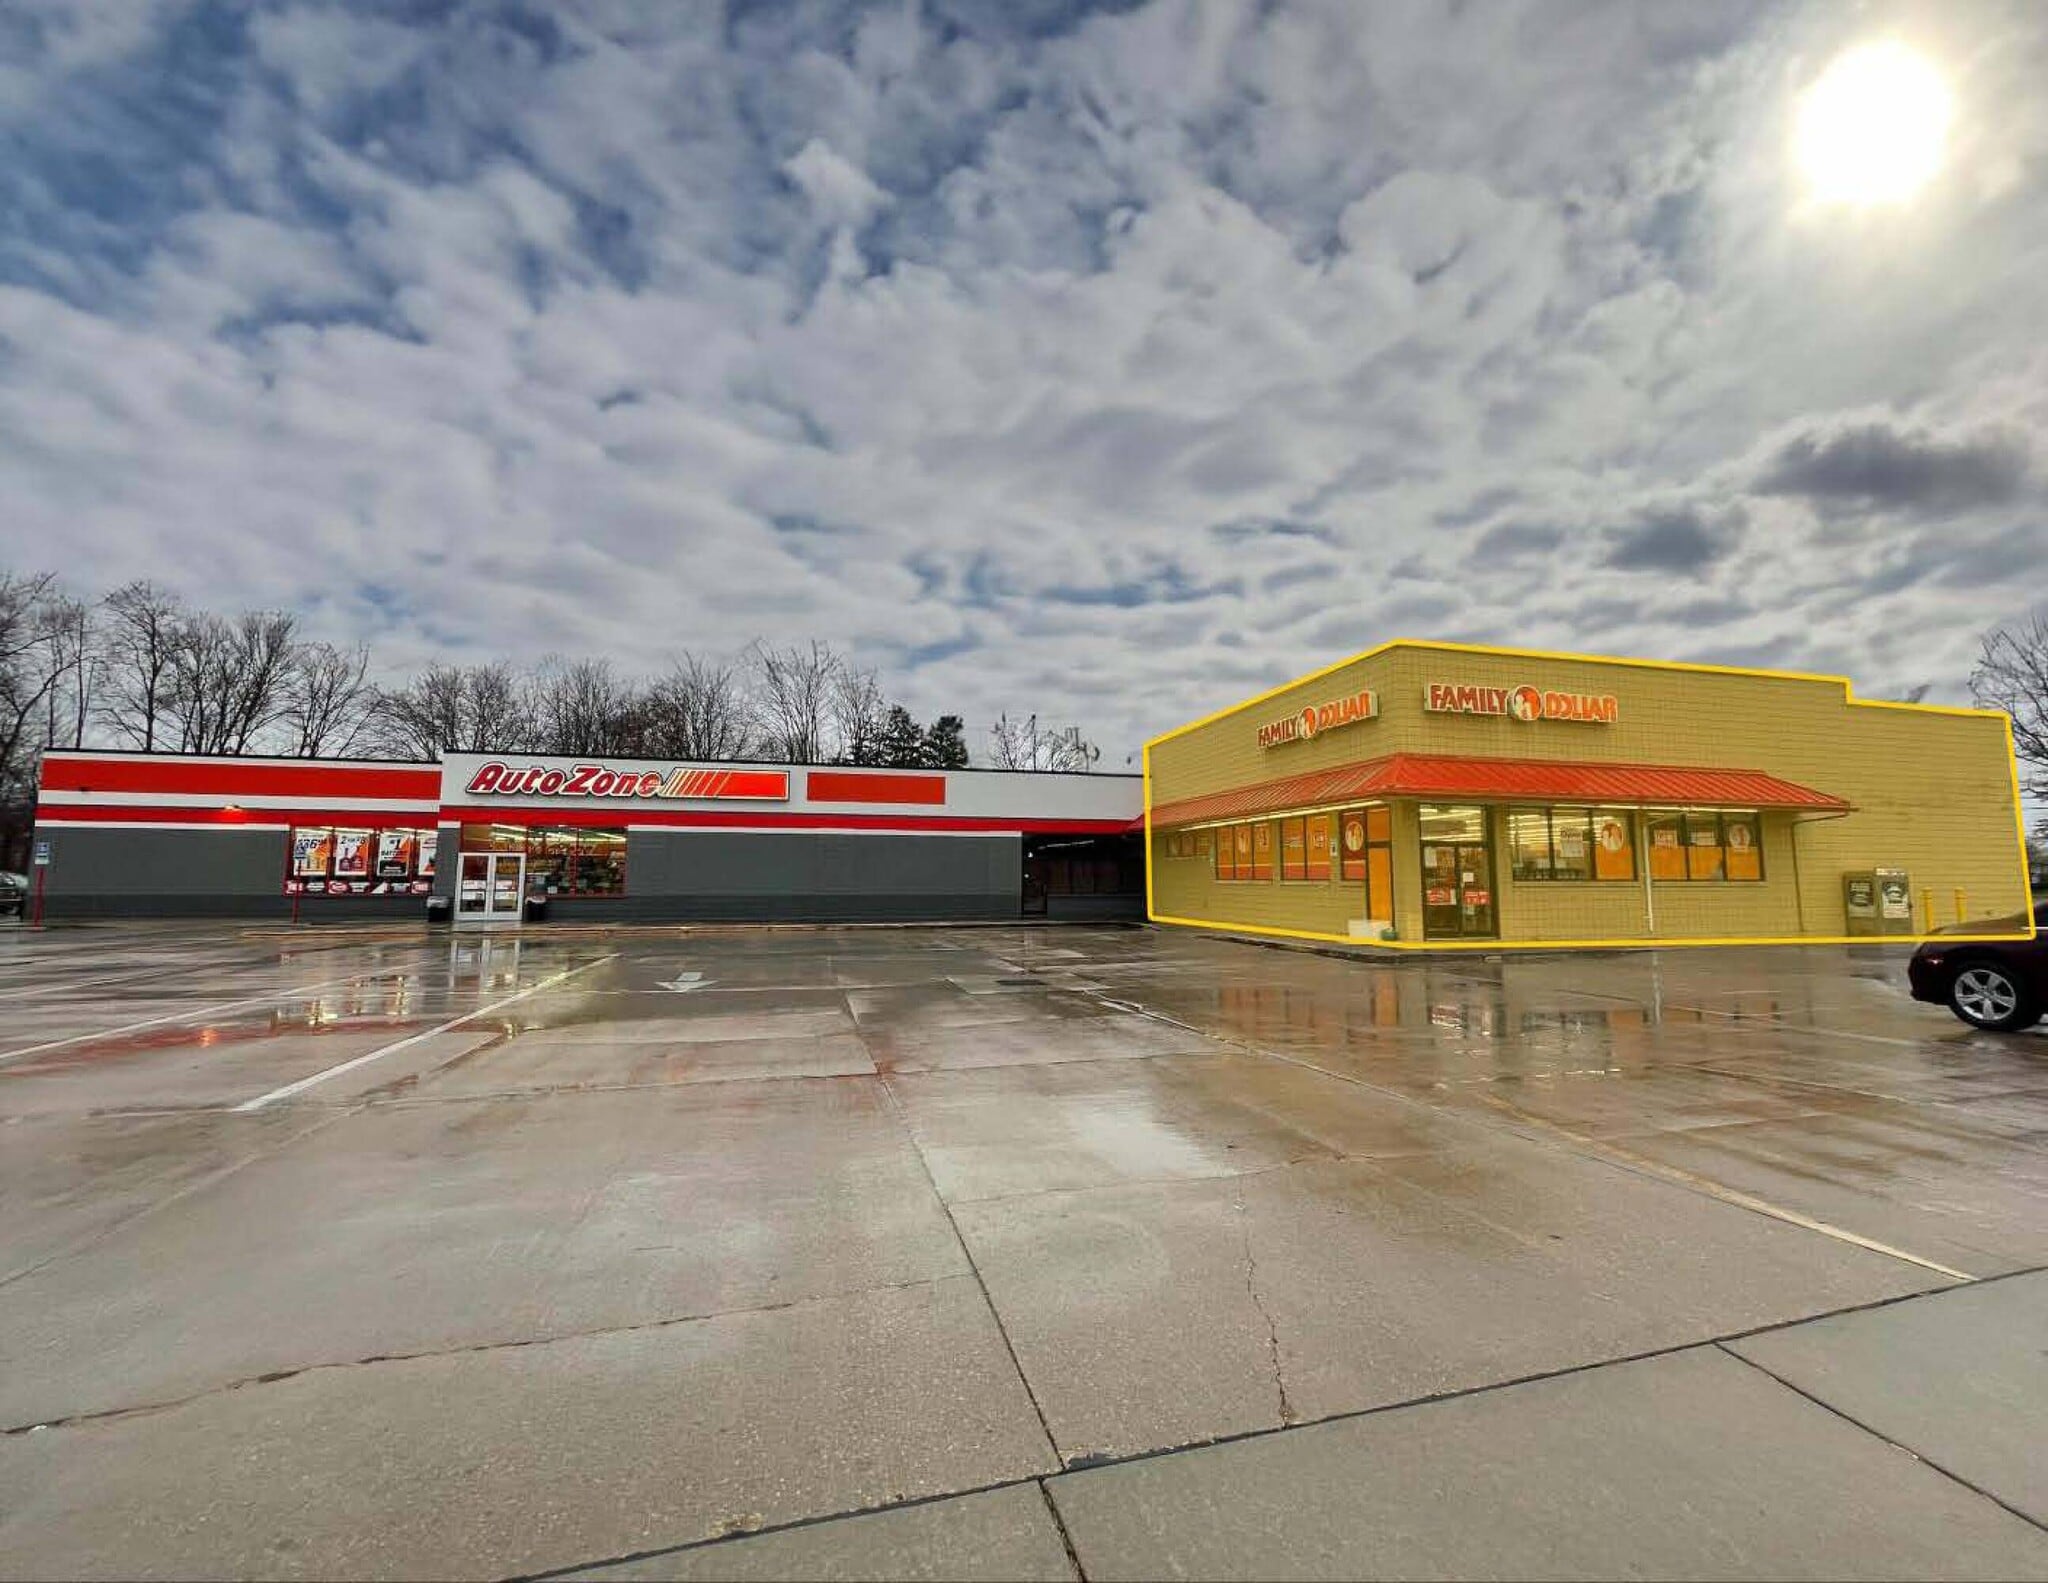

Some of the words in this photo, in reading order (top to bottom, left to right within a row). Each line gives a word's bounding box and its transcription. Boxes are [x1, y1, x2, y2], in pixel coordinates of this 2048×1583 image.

[1429, 683, 1510, 715] FAMILY
[1544, 691, 1619, 722] DOLLAR
[1257, 715, 1299, 748] FAMILY
[466, 762, 663, 797] AutoZone
